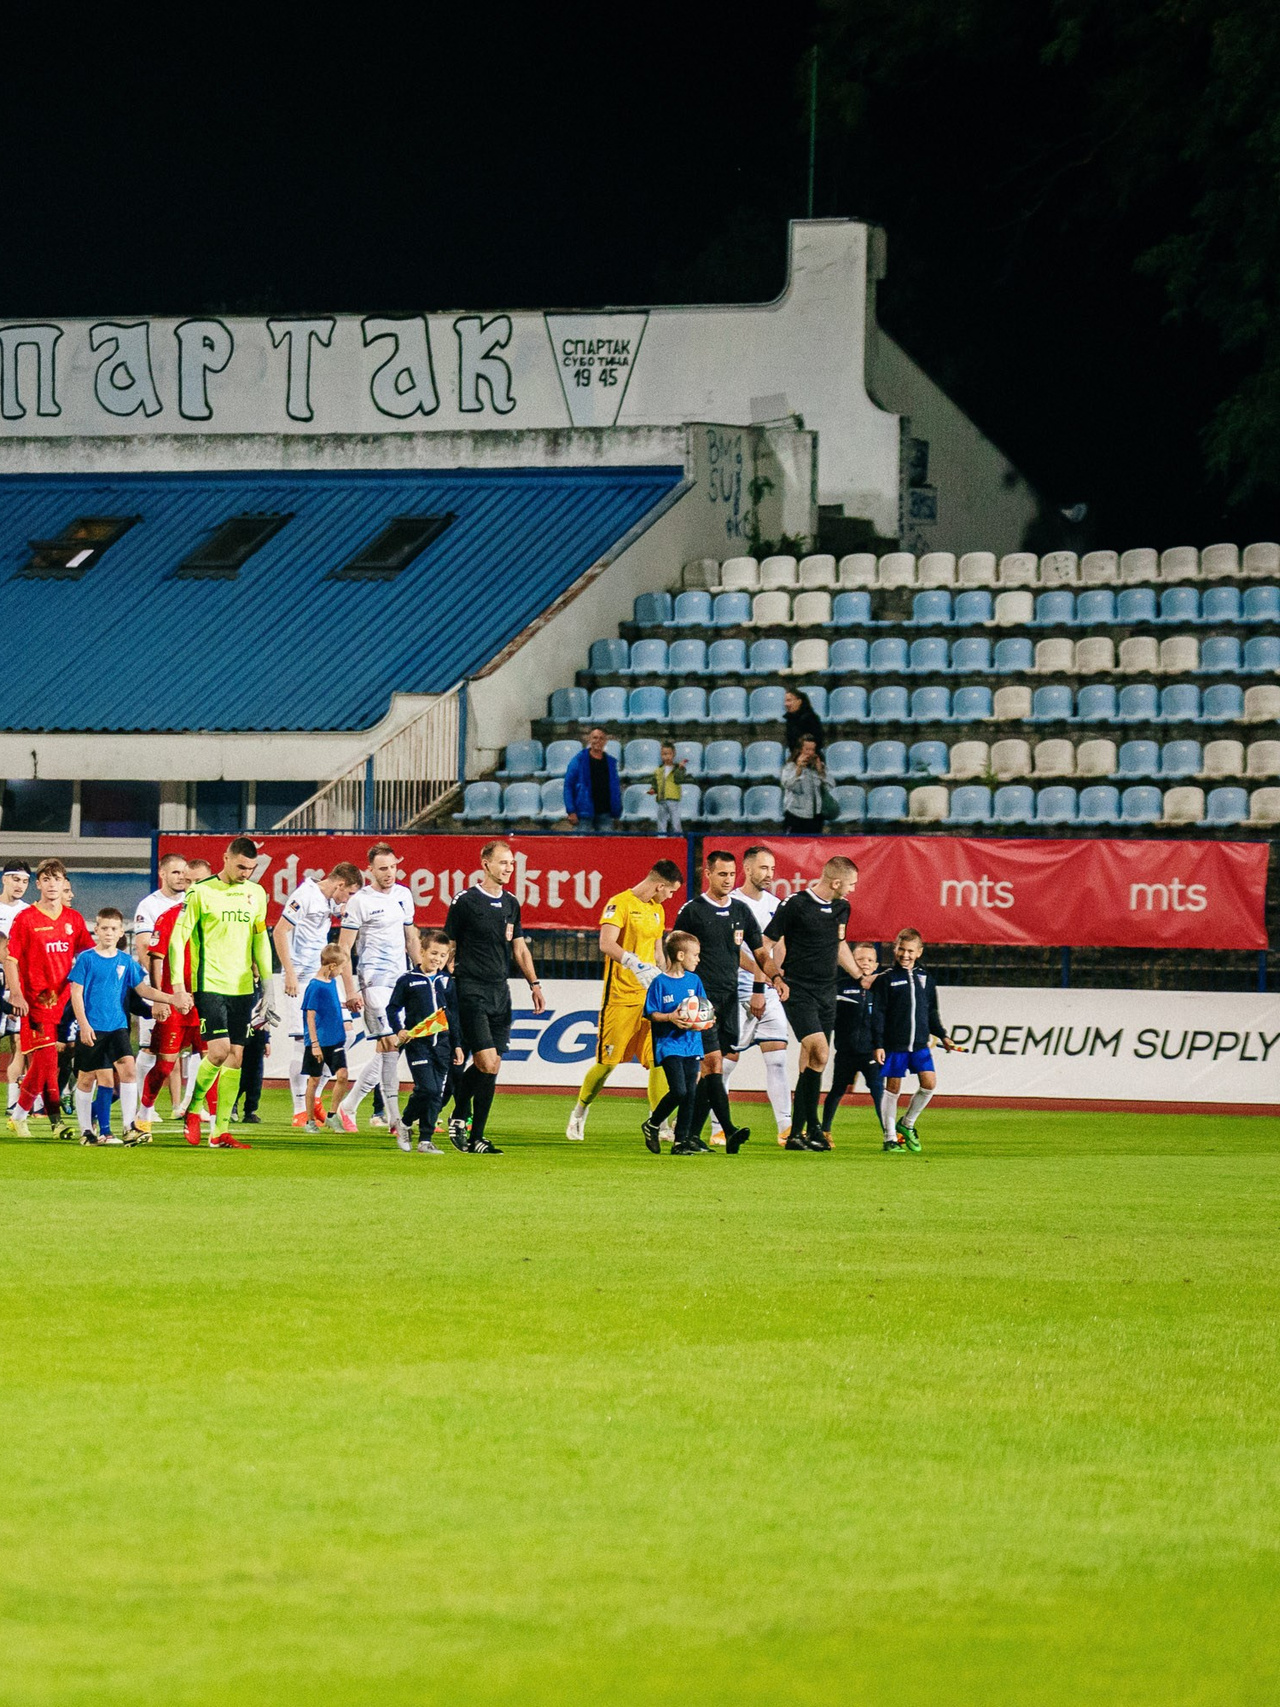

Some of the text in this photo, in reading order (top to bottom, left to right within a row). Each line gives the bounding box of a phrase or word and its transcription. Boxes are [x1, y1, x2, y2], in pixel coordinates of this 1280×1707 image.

[562, 339, 631, 355] СПАРТАК
[515, 851, 603, 908] krv
[940, 874, 1015, 908] mts
[1129, 877, 1208, 912] mts
[222, 909, 251, 922] mts
[46, 940, 69, 953] mts
[946, 1025, 1124, 1057] PREMIUM
[1133, 1028, 1280, 1062] SUPPLY
